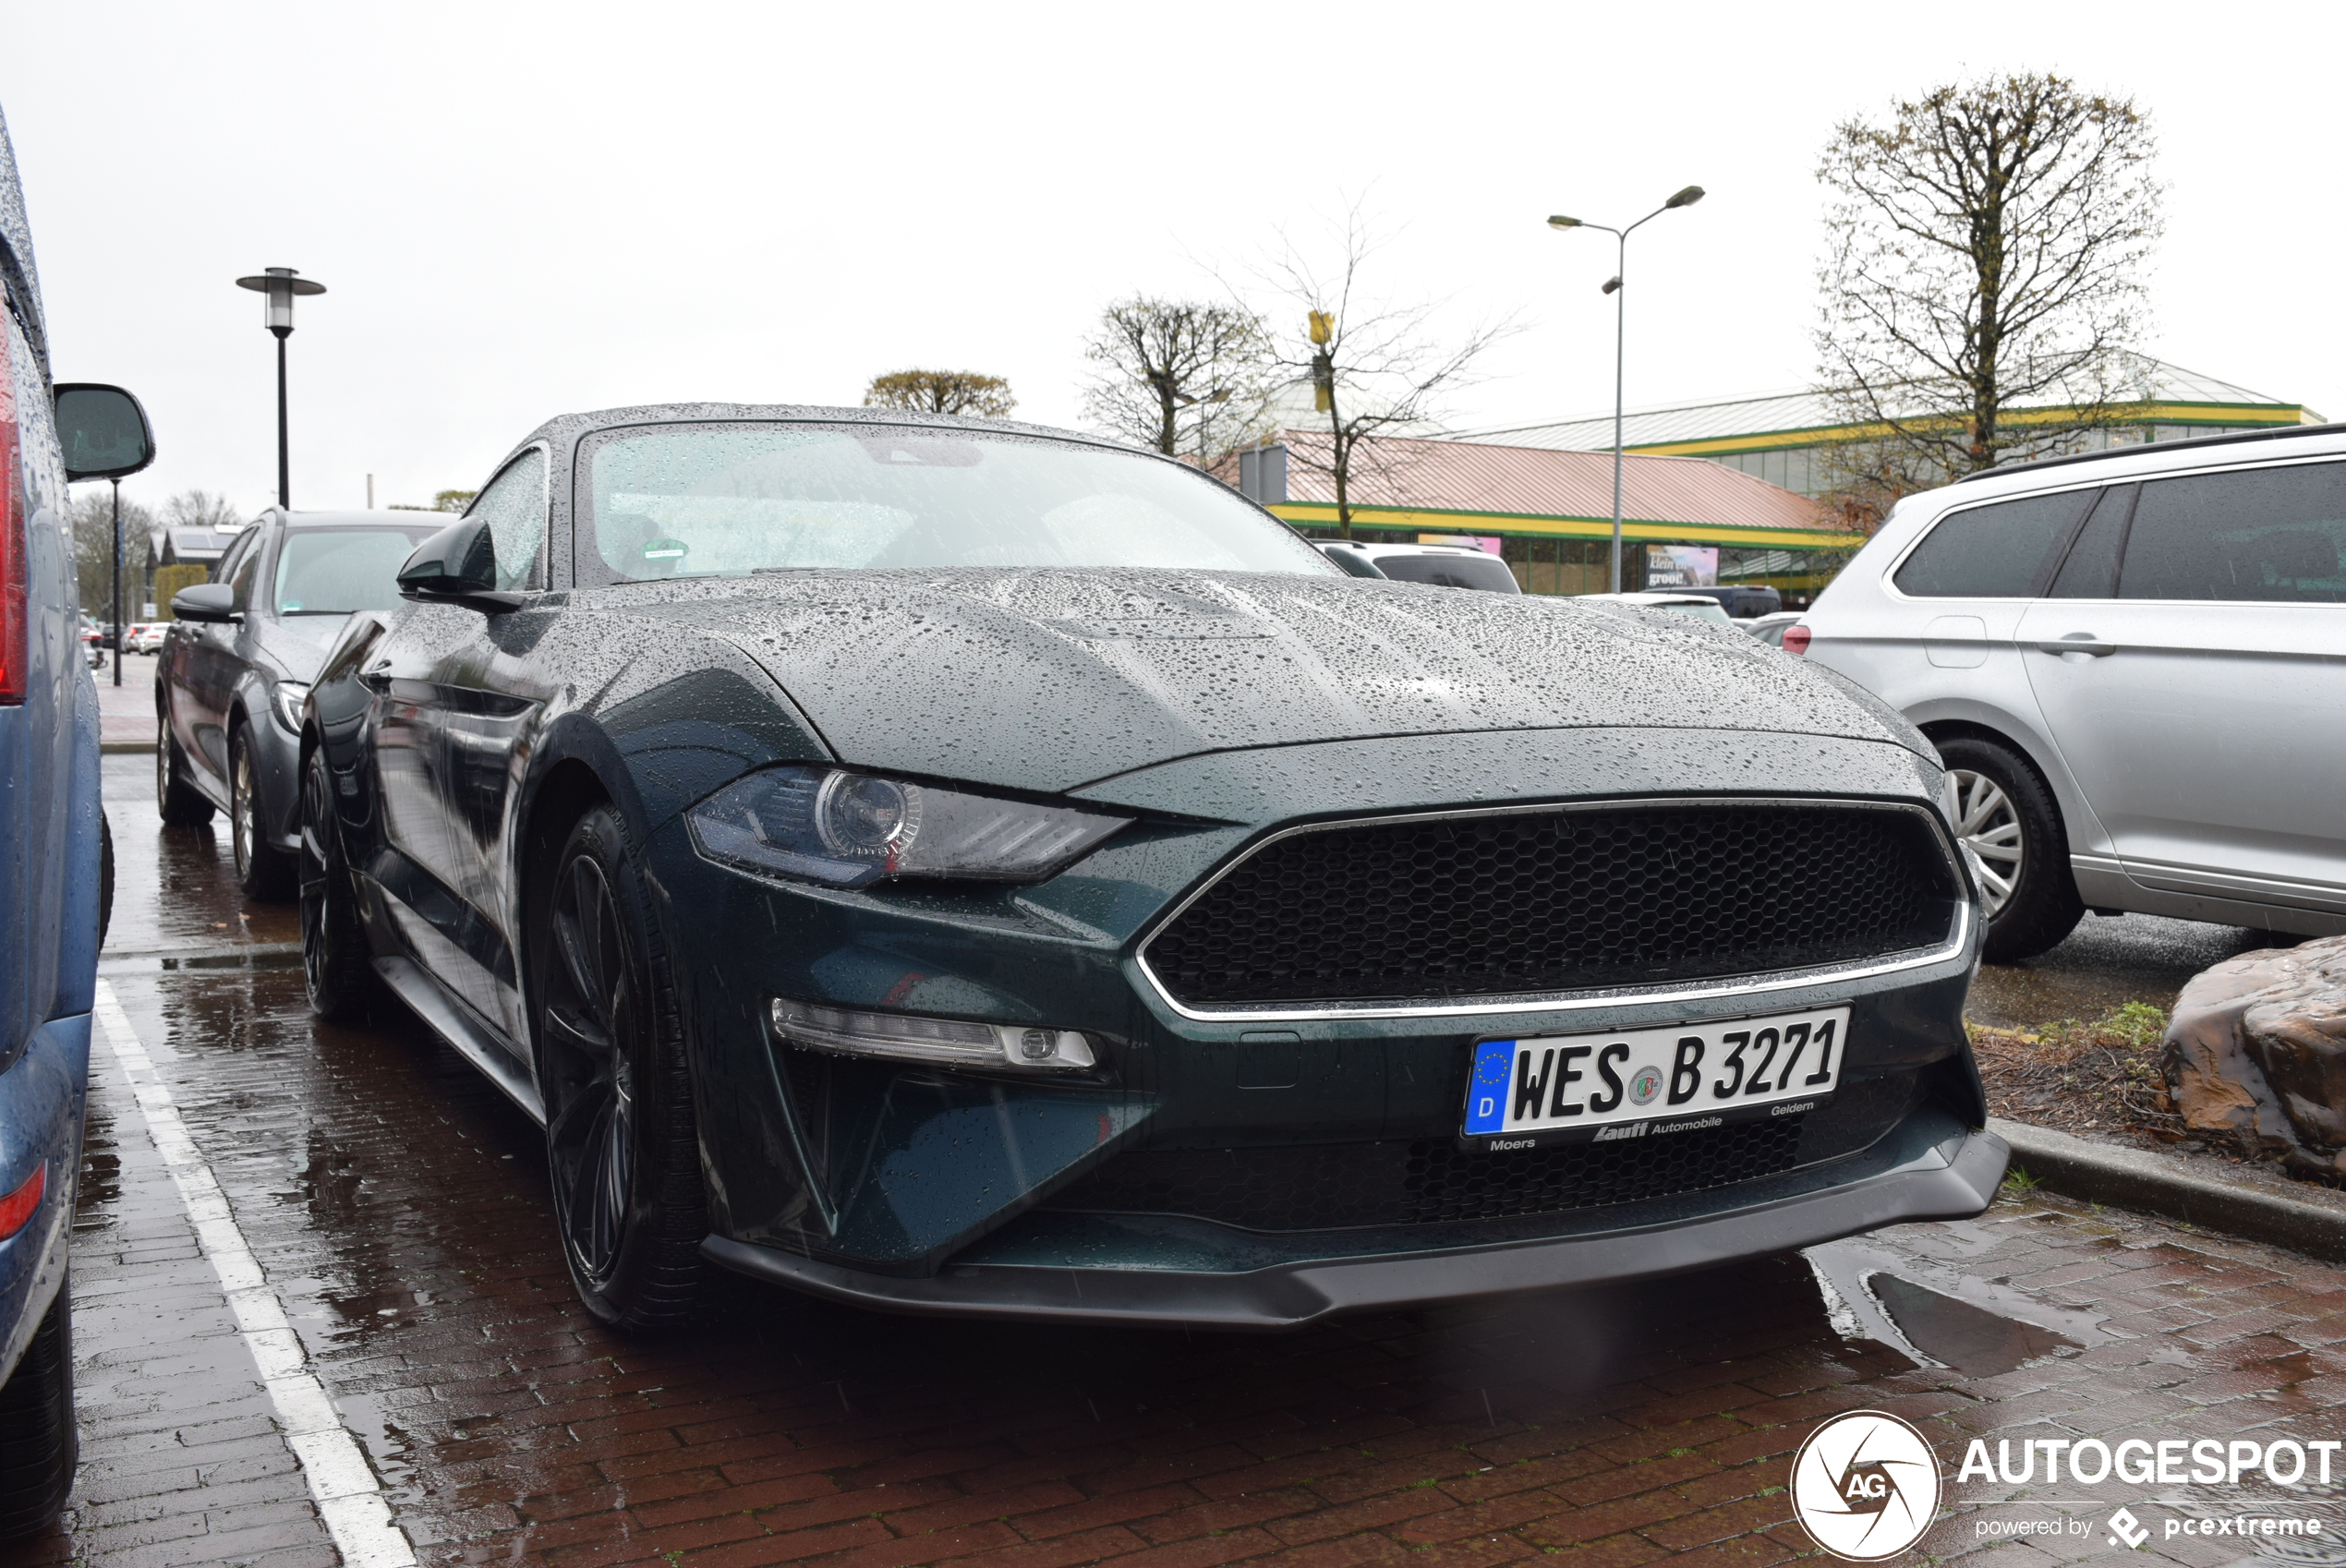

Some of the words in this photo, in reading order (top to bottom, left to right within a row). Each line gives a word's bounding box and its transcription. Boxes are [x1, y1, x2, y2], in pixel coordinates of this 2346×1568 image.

[1650, 557, 1674, 570] klein
[1649, 573, 1684, 587] groot!
[1513, 1043, 1630, 1121] WES
[1666, 1035, 1705, 1105] B
[1712, 1019, 1836, 1100] 3271
[1479, 1097, 1494, 1117] D
[1771, 1101, 1814, 1116] Geldern
[1592, 1121, 1649, 1142] Lauff
[1651, 1116, 1723, 1135] Automobile
[1490, 1139, 1536, 1152] Moers
